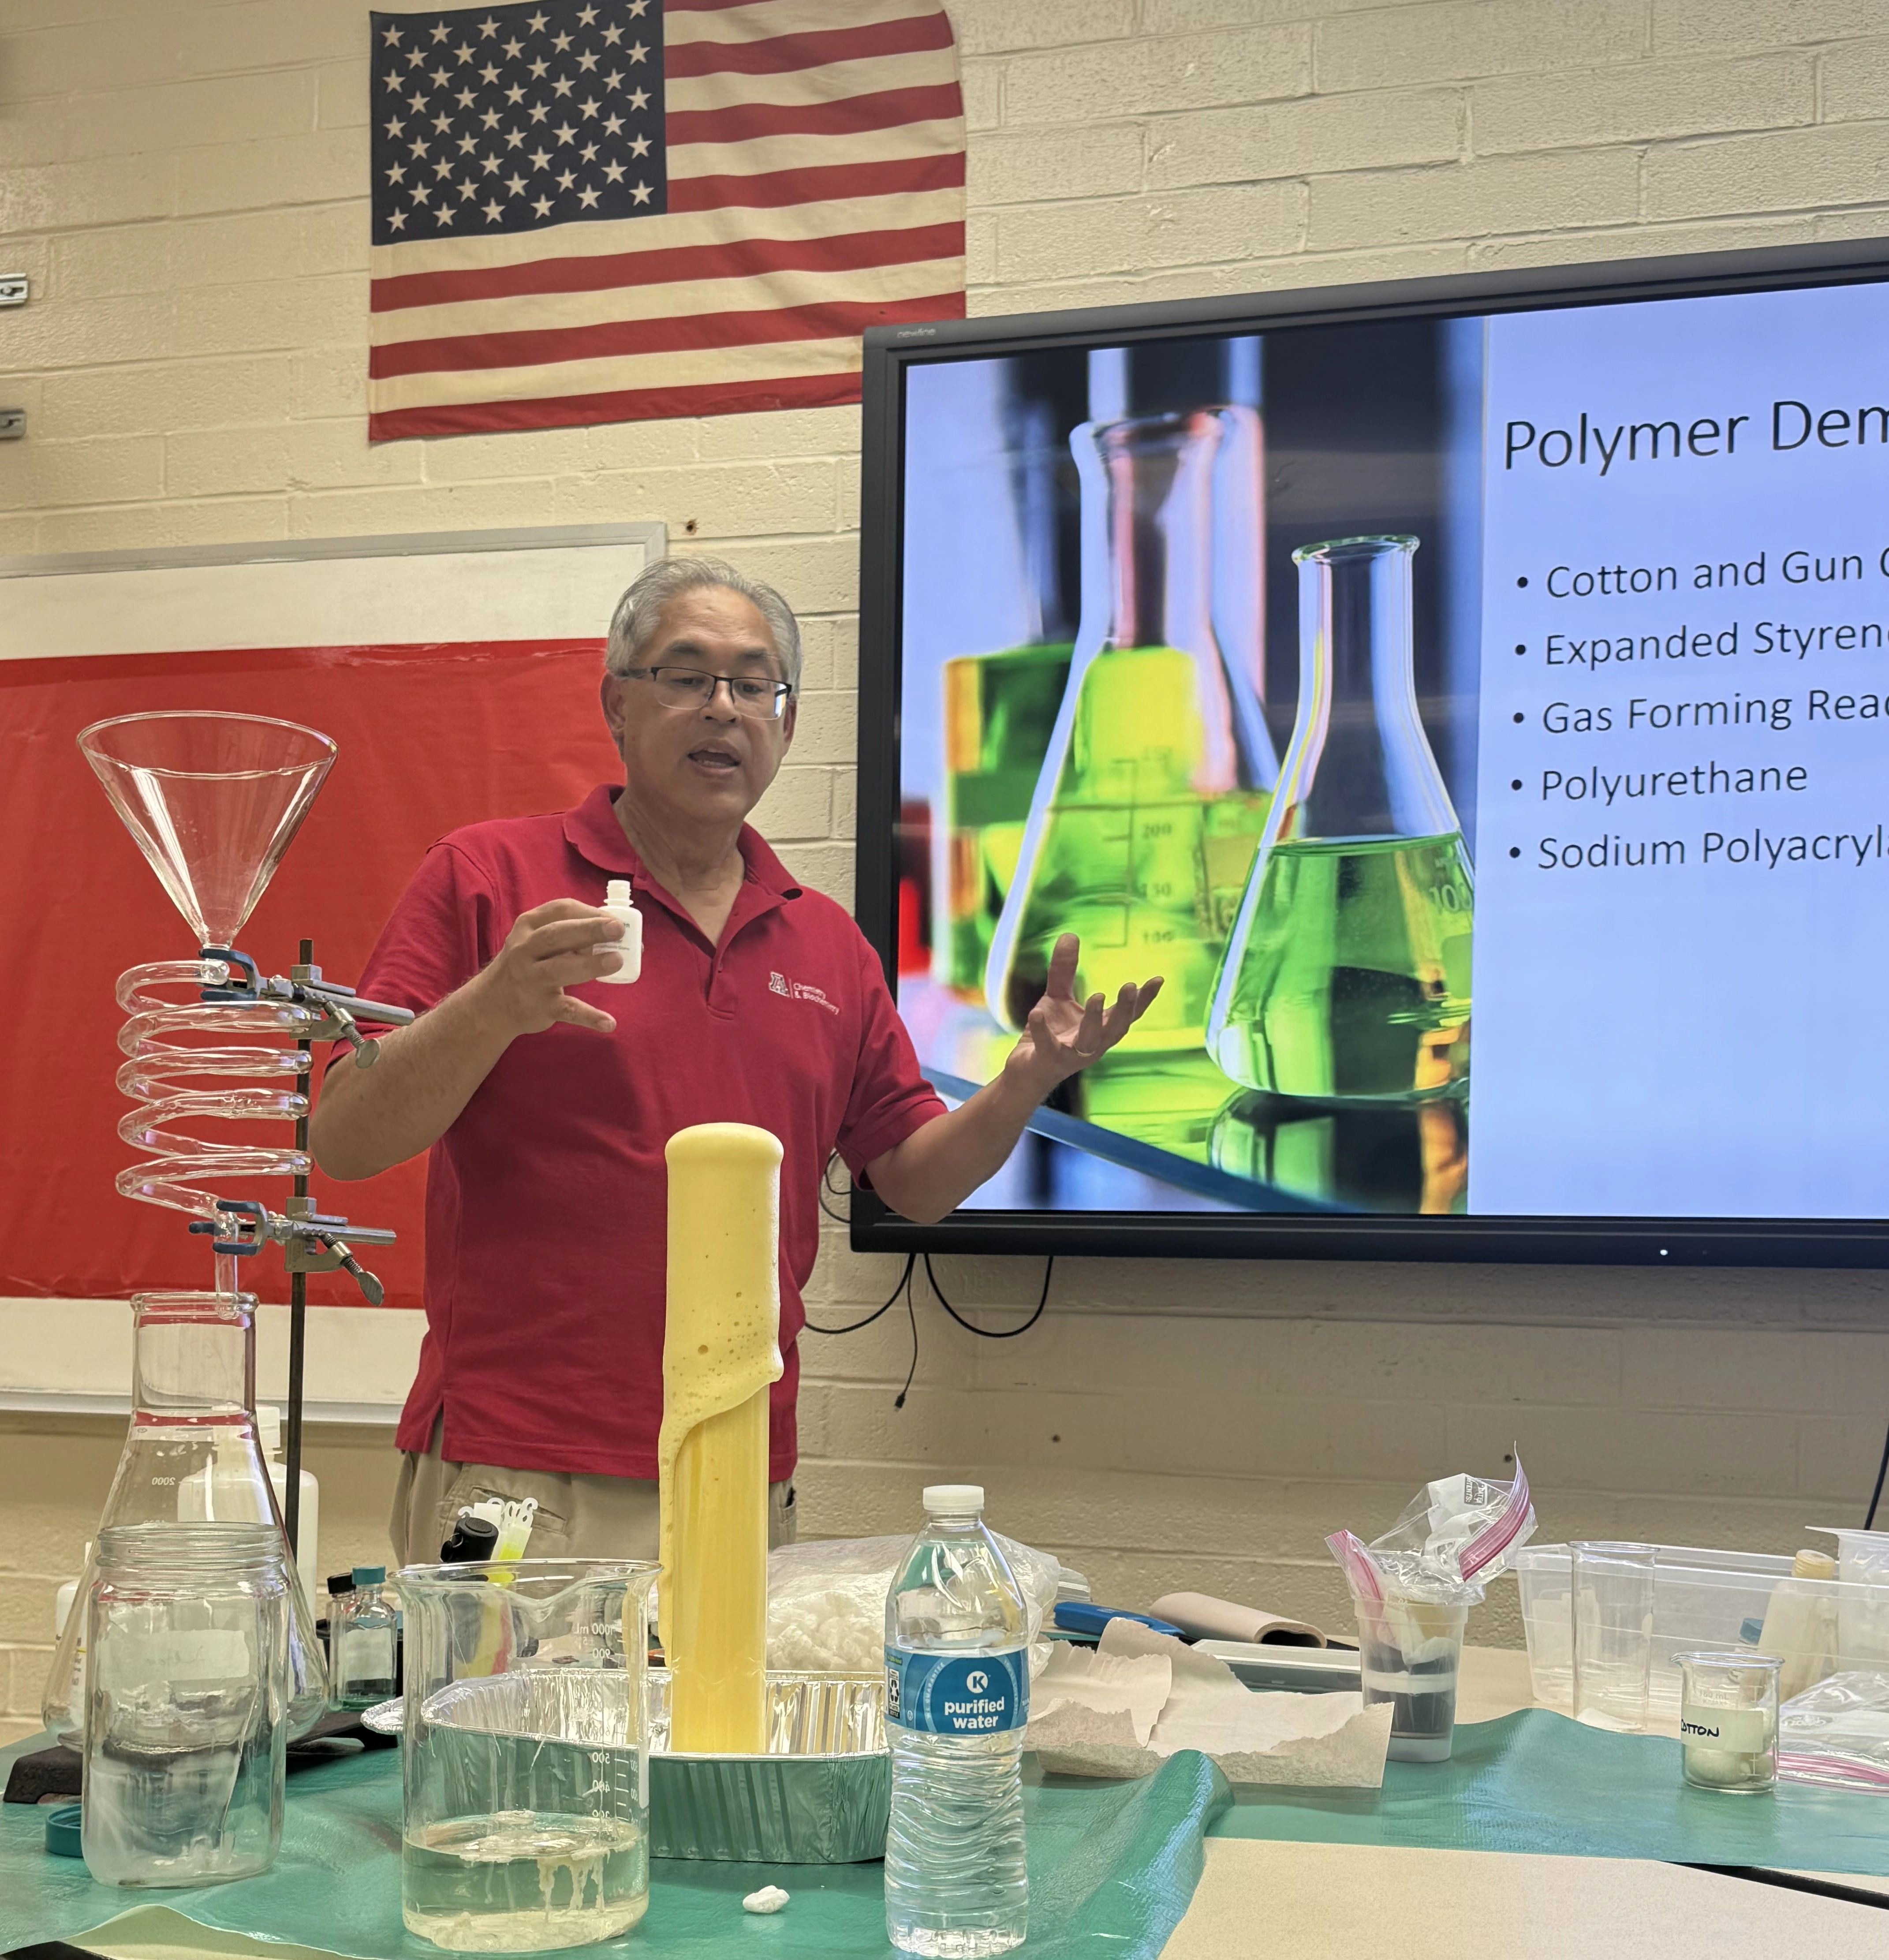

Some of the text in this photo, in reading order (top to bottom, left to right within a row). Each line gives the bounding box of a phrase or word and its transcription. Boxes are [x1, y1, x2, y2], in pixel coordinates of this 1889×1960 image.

[1506, 413, 1750, 476] Polymer
[1547, 565, 1676, 598] Cotton
[1694, 552, 1765, 589] and
[1782, 551, 1862, 583] Gun
[1547, 622, 1889, 671] Expanded Styren
[1543, 690, 1889, 733] Gas Forming Rea
[1543, 761, 1807, 806] Polyurethane
[1538, 825, 1889, 870] Sodium Polyacryl
[1429, 883, 1473, 915] 100
[944, 1696, 1005, 1715] purified
[952, 1715, 999, 1729] water
